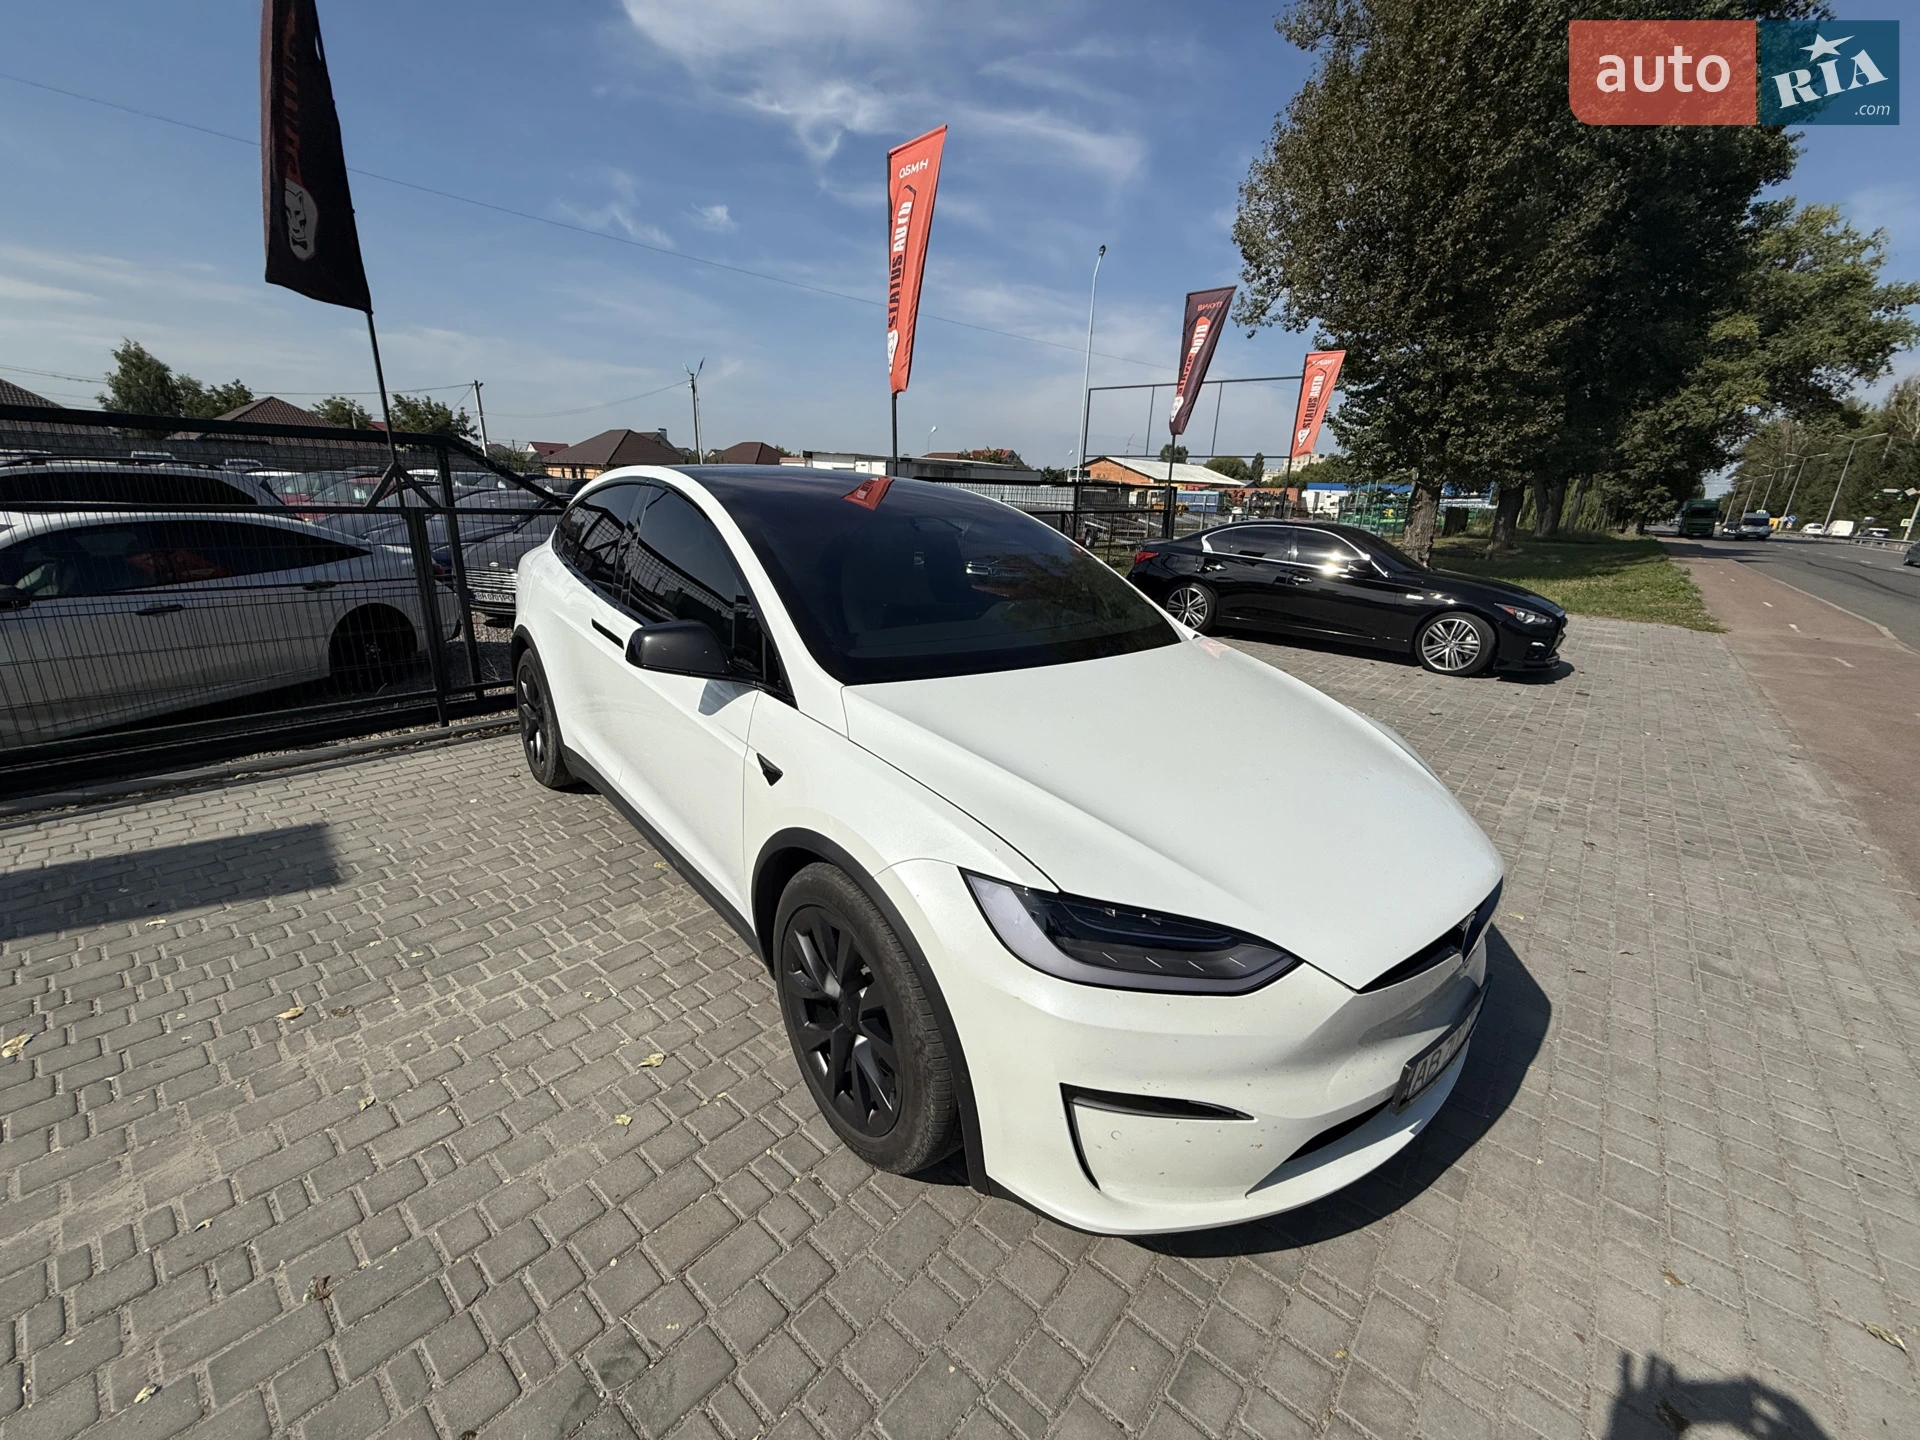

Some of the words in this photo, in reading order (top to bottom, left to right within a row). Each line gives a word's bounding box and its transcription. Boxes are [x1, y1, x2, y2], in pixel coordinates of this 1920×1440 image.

[893, 201, 912, 253] AUTO
[888, 254, 903, 329] STATUS
[1309, 375, 1325, 397] AUTO
[1303, 397, 1318, 429] STATUS
